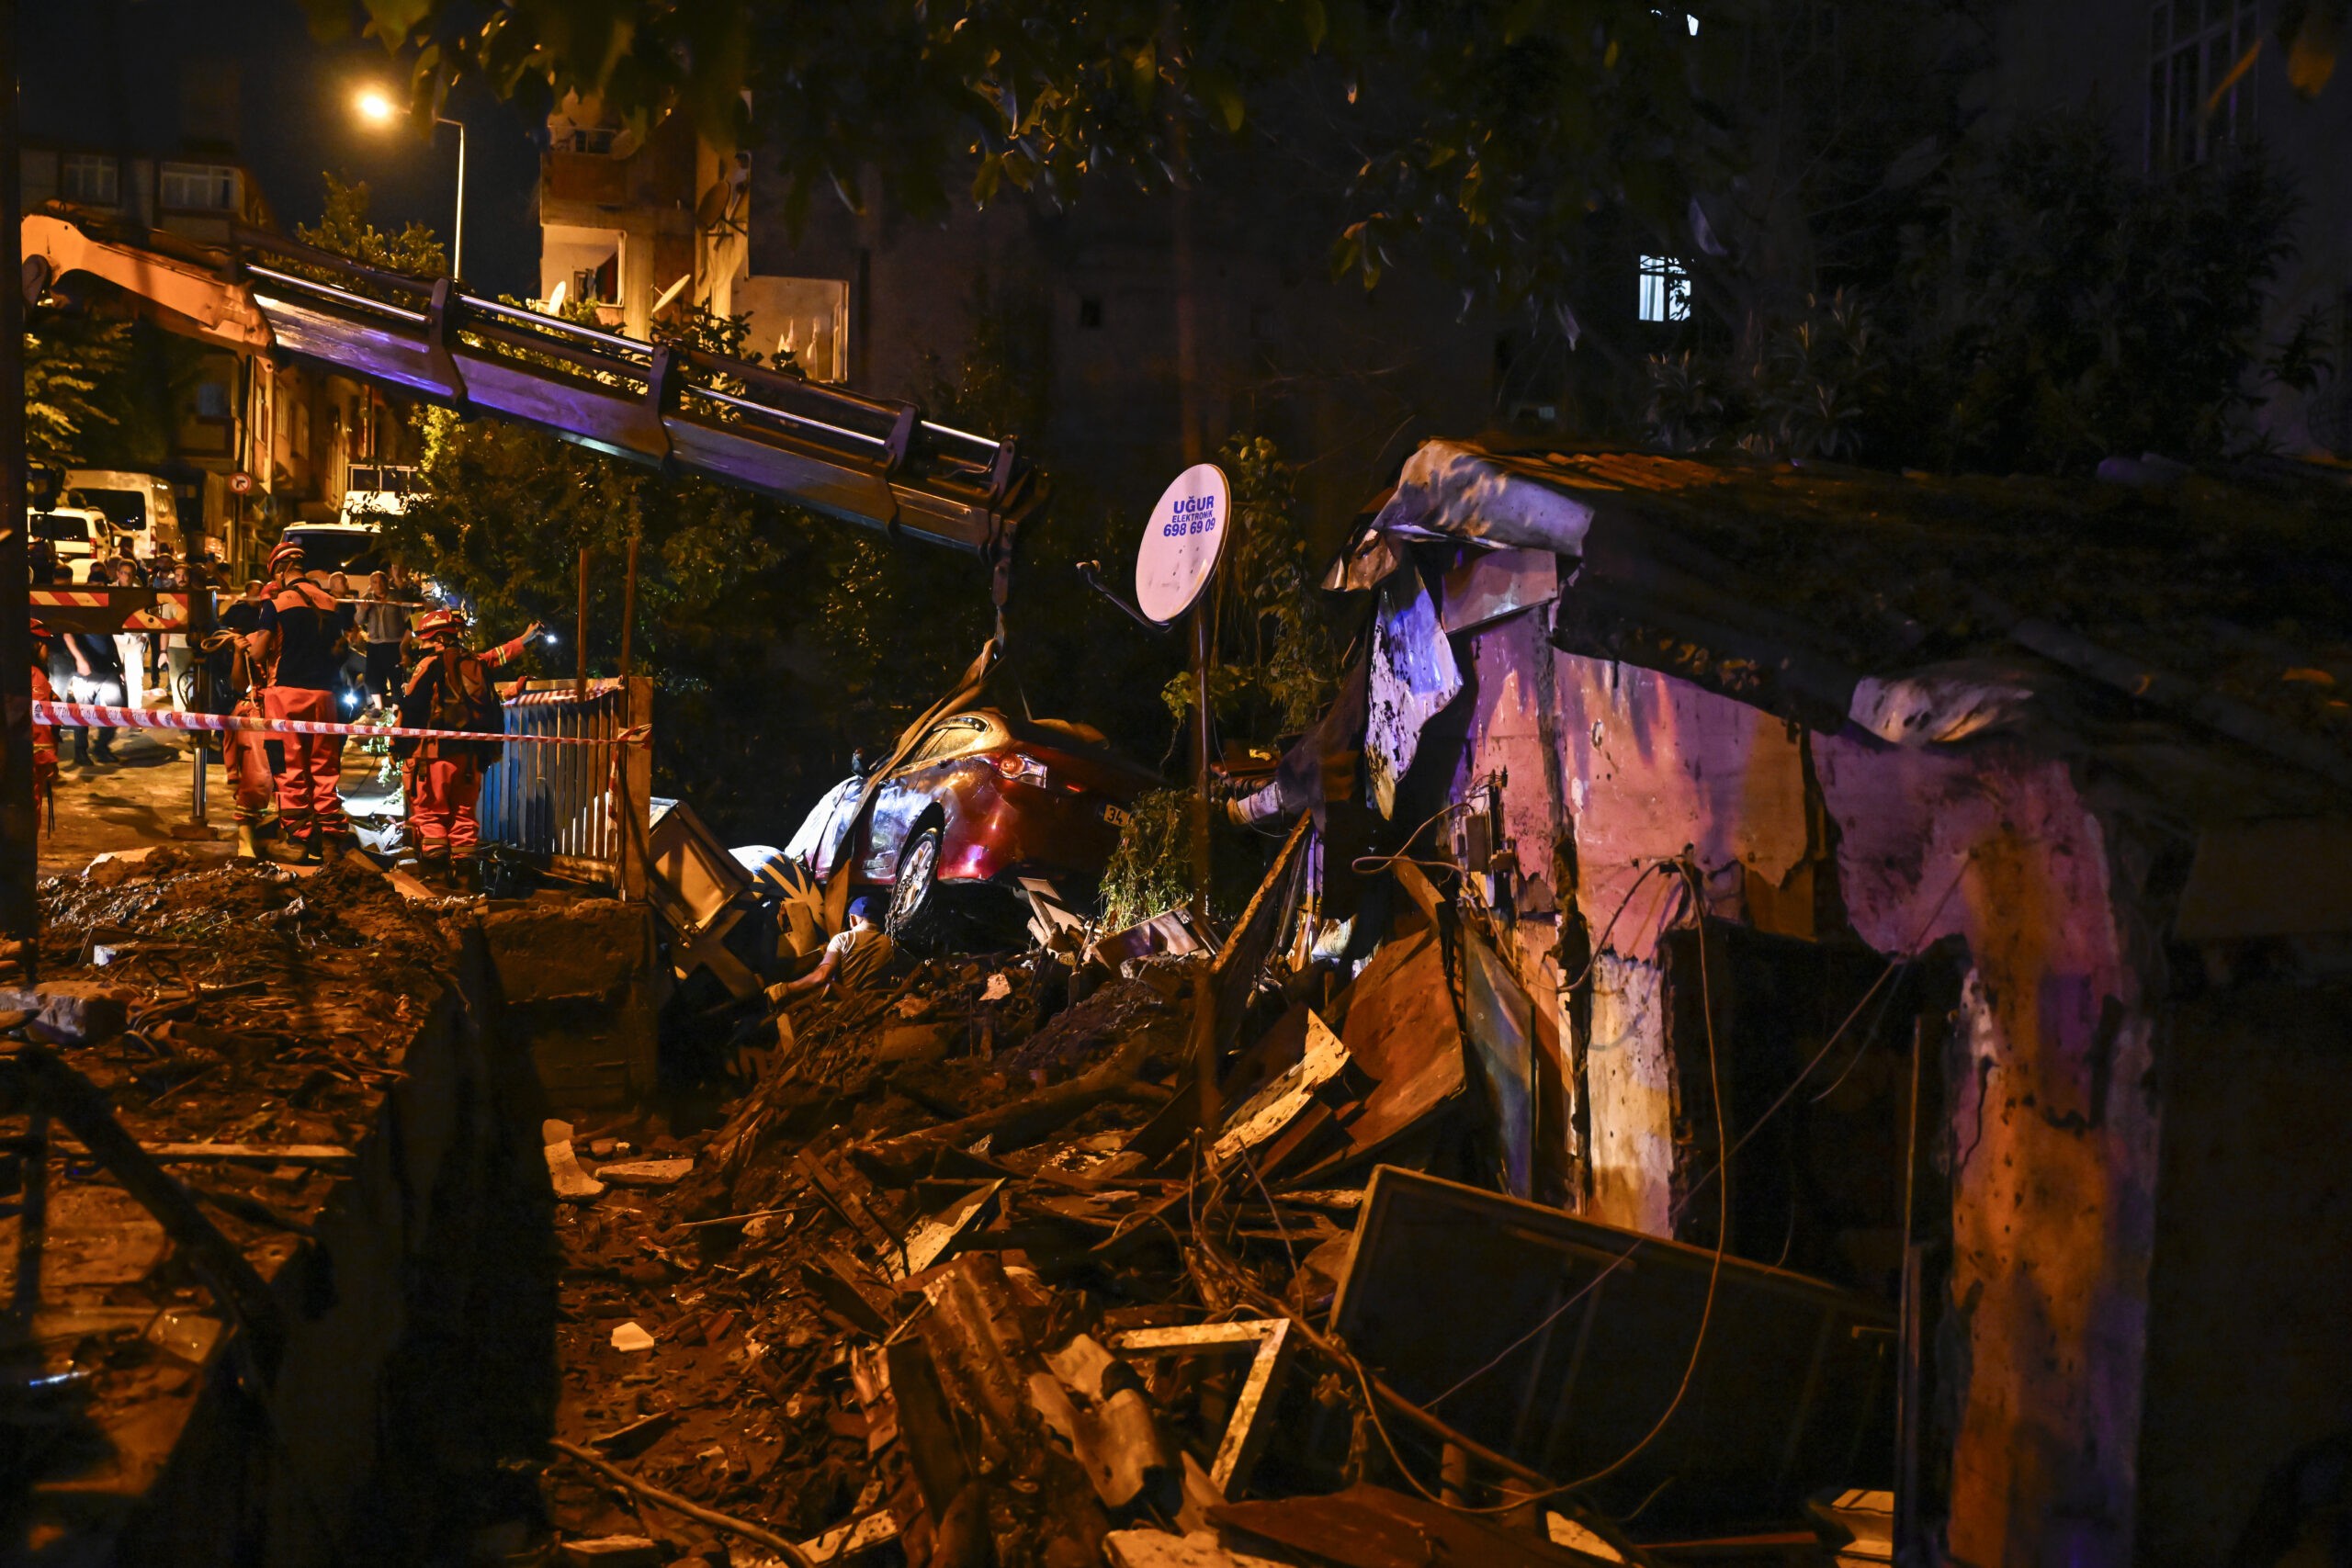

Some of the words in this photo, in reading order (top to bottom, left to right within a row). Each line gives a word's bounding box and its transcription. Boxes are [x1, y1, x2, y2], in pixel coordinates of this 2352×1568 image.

[1173, 495, 1214, 514] UĞUR
[1163, 523, 1187, 537] 698
[1190, 520, 1204, 535] 69
[1205, 517, 1216, 532] 09
[1107, 807, 1123, 824] 34
